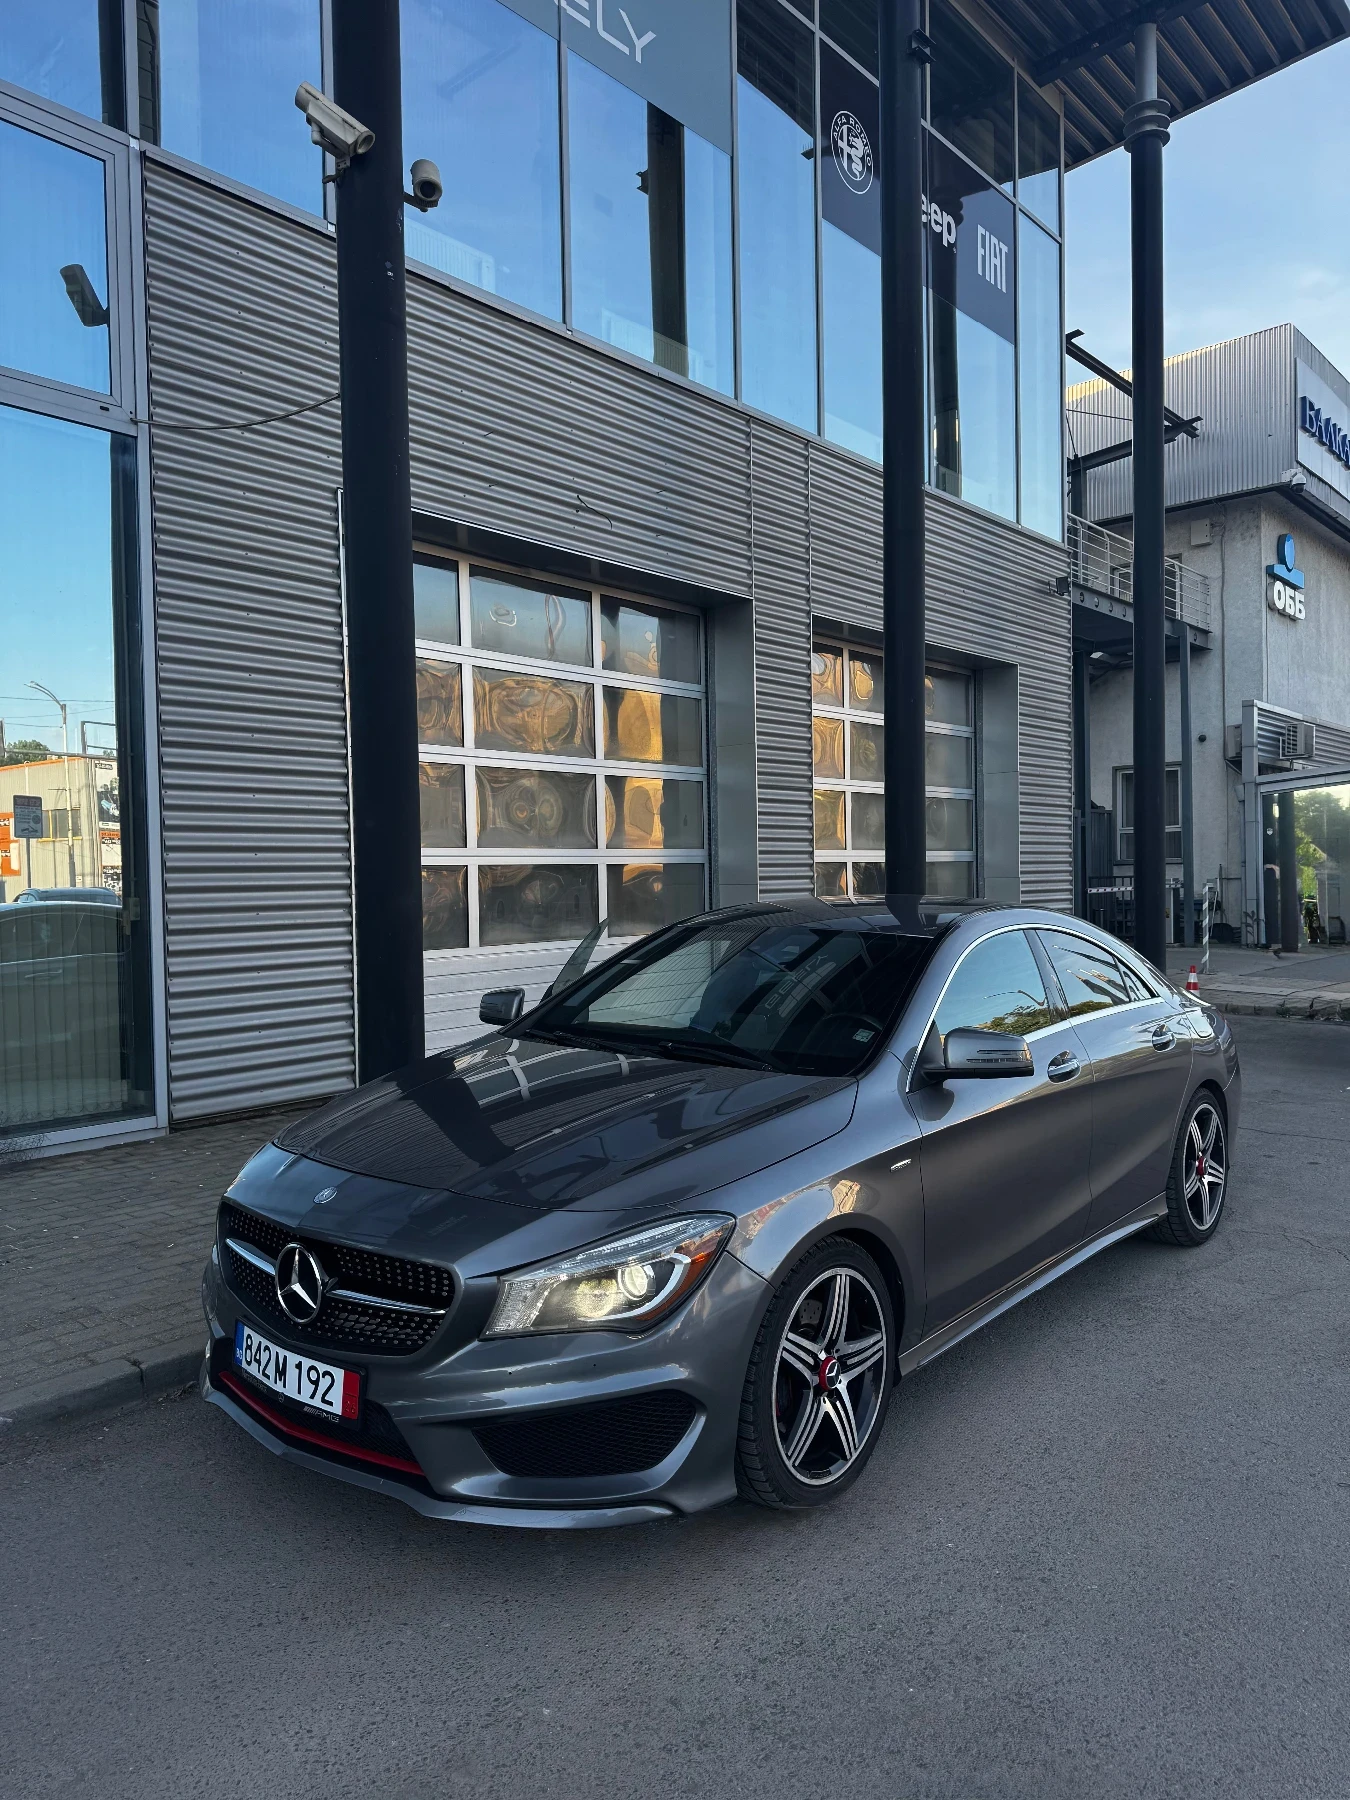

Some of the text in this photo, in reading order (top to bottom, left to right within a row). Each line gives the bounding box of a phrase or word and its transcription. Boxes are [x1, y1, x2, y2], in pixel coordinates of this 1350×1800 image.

[833, 115, 872, 167] ALFA ROMEO
[921, 193, 957, 248] eep
[977, 223, 1009, 294] FIAT
[1270, 580, 1306, 622] ОББ
[244, 1333, 288, 1389] 842M
[294, 1360, 336, 1408] 192
